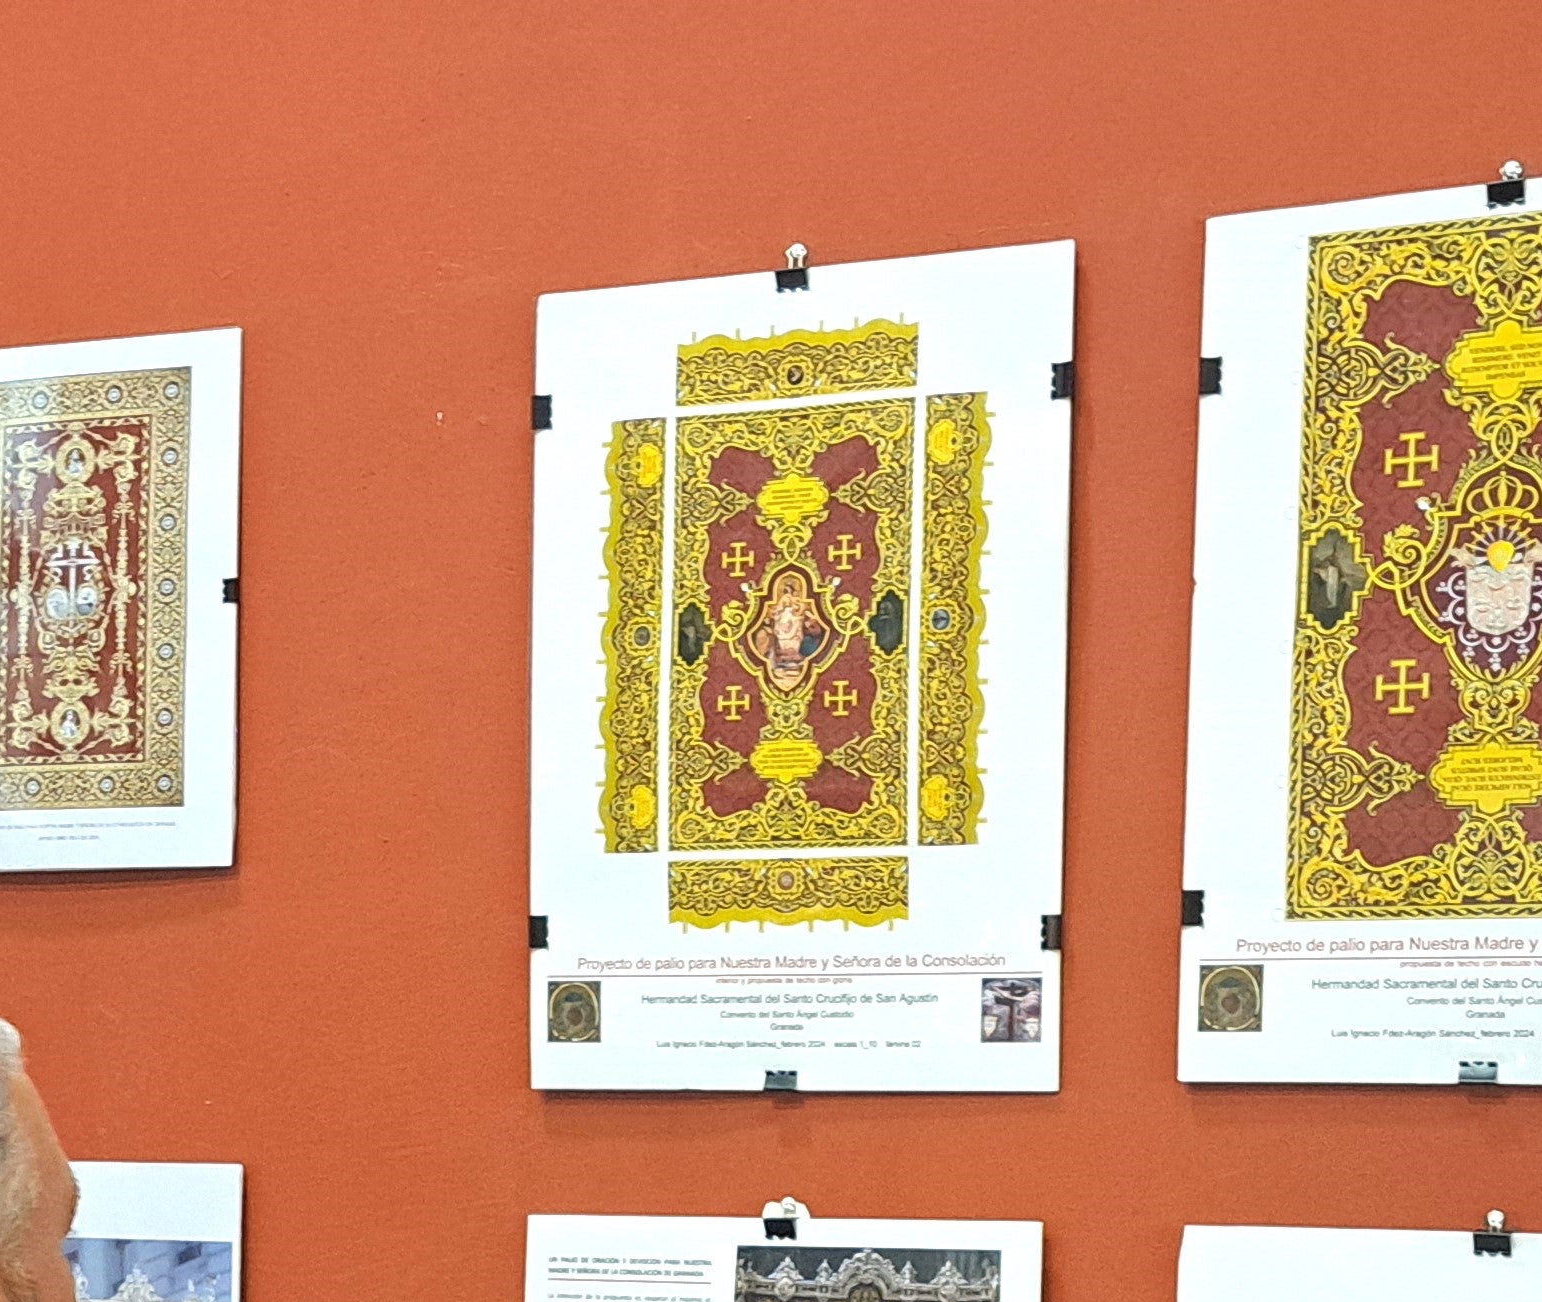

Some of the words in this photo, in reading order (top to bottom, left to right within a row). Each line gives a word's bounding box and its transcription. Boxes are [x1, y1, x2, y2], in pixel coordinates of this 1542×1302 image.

[1236, 938, 1302, 955] Proyecto
[1305, 939, 1325, 952] de
[1329, 937, 1366, 954] palio
[1369, 940, 1404, 954] para
[1409, 937, 1469, 951] Nuestra
[1474, 936, 1525, 950] Madre
[1528, 939, 1539, 953] y
[577, 957, 633, 973] Proyecto
[635, 957, 652, 969] de
[654, 957, 685, 971] palio
[688, 959, 717, 971] para
[720, 956, 771, 969] Nuestra
[775, 955, 817, 968] Madre
[820, 958, 829, 971] y
[832, 954, 881, 968] Señora
[884, 954, 902, 967] de
[905, 954, 918, 967] la
[921, 953, 1006, 967] Consolación
[1311, 978, 1380, 989] Hermandad
[1382, 978, 1457, 989] Sacramental
[1460, 977, 1479, 989] del
[1482, 977, 1518, 989] Santo
[641, 994, 698, 1004] Hermandad
[700, 993, 762, 1004] Sacramental
[764, 994, 781, 1004] del
[783, 993, 813, 1004] Santo
[815, 993, 857, 1006] Crucifijo
[859, 993, 873, 1004] de
[875, 992, 897, 1003] San
[898, 992, 939, 1006] Agustín
